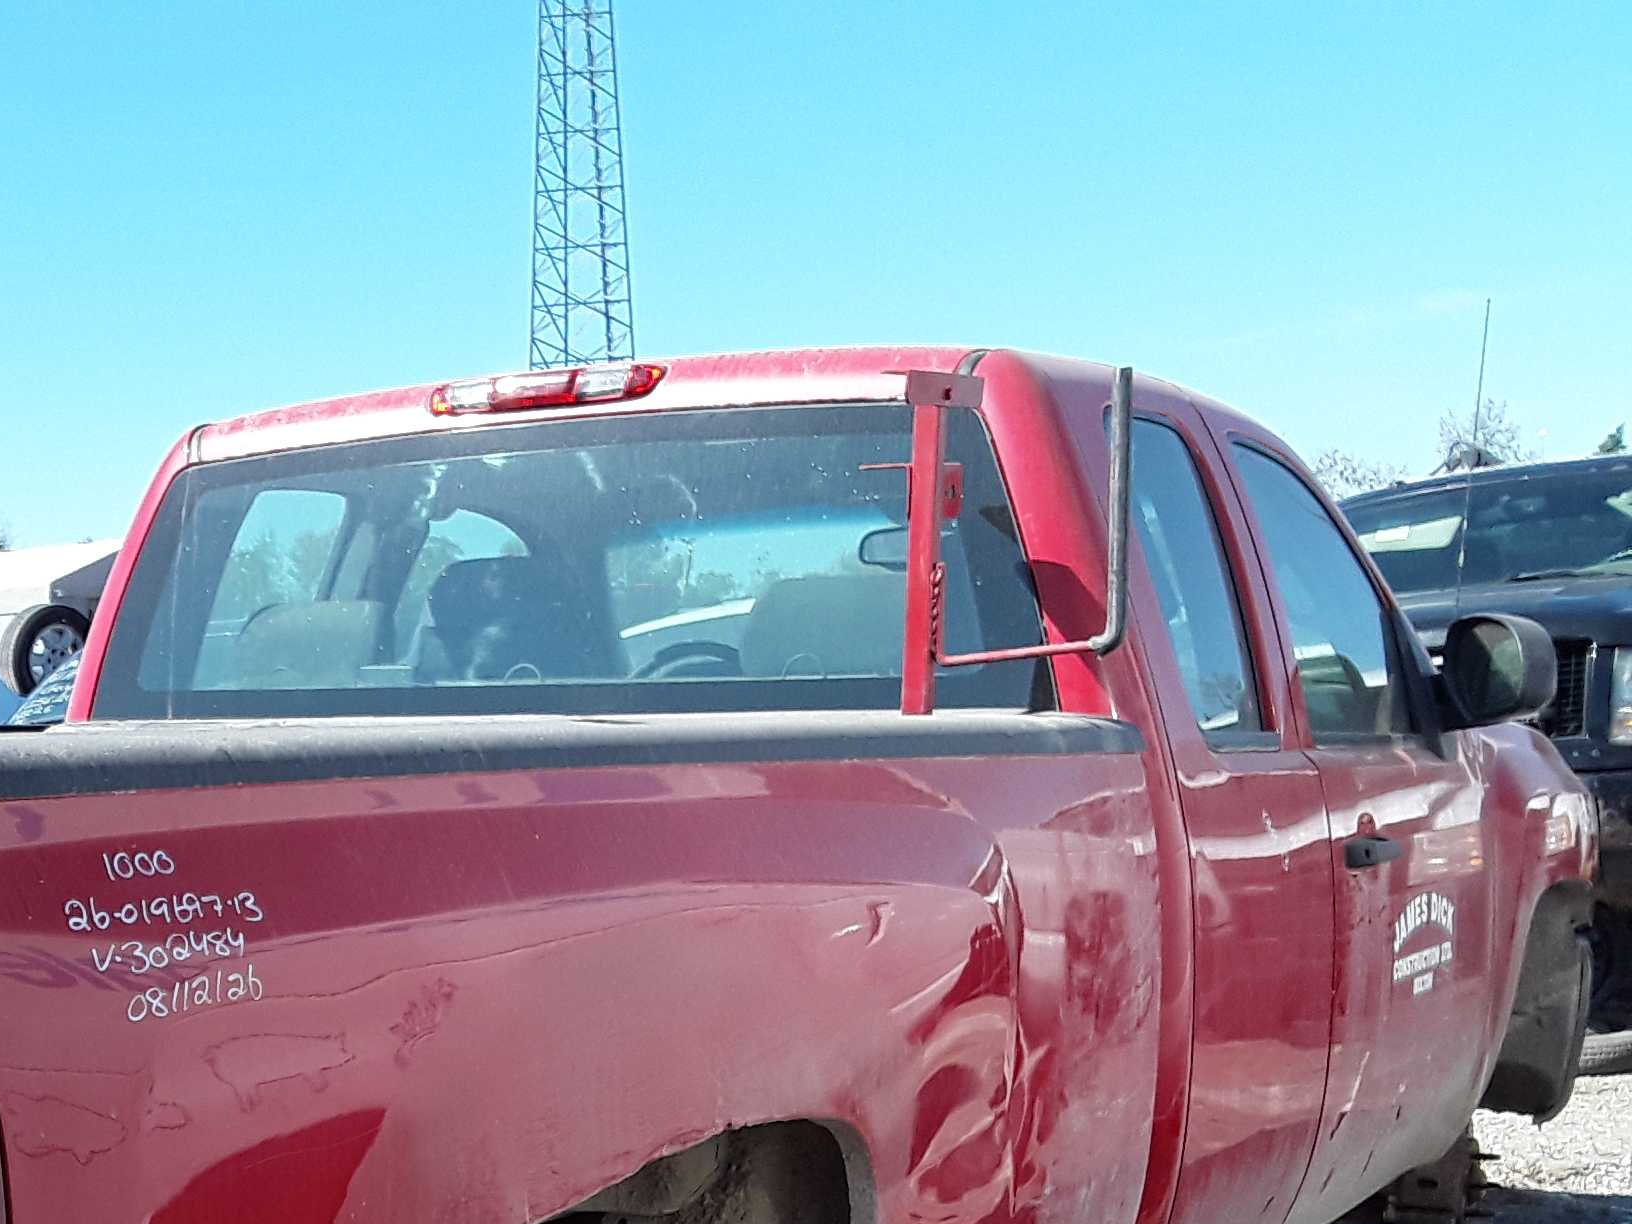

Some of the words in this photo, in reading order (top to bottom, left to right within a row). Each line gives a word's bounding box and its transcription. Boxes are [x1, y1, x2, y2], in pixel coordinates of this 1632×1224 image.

[102, 850, 175, 881] 1000
[1394, 893, 1428, 954] JAMES
[1430, 892, 1456, 936] DICK
